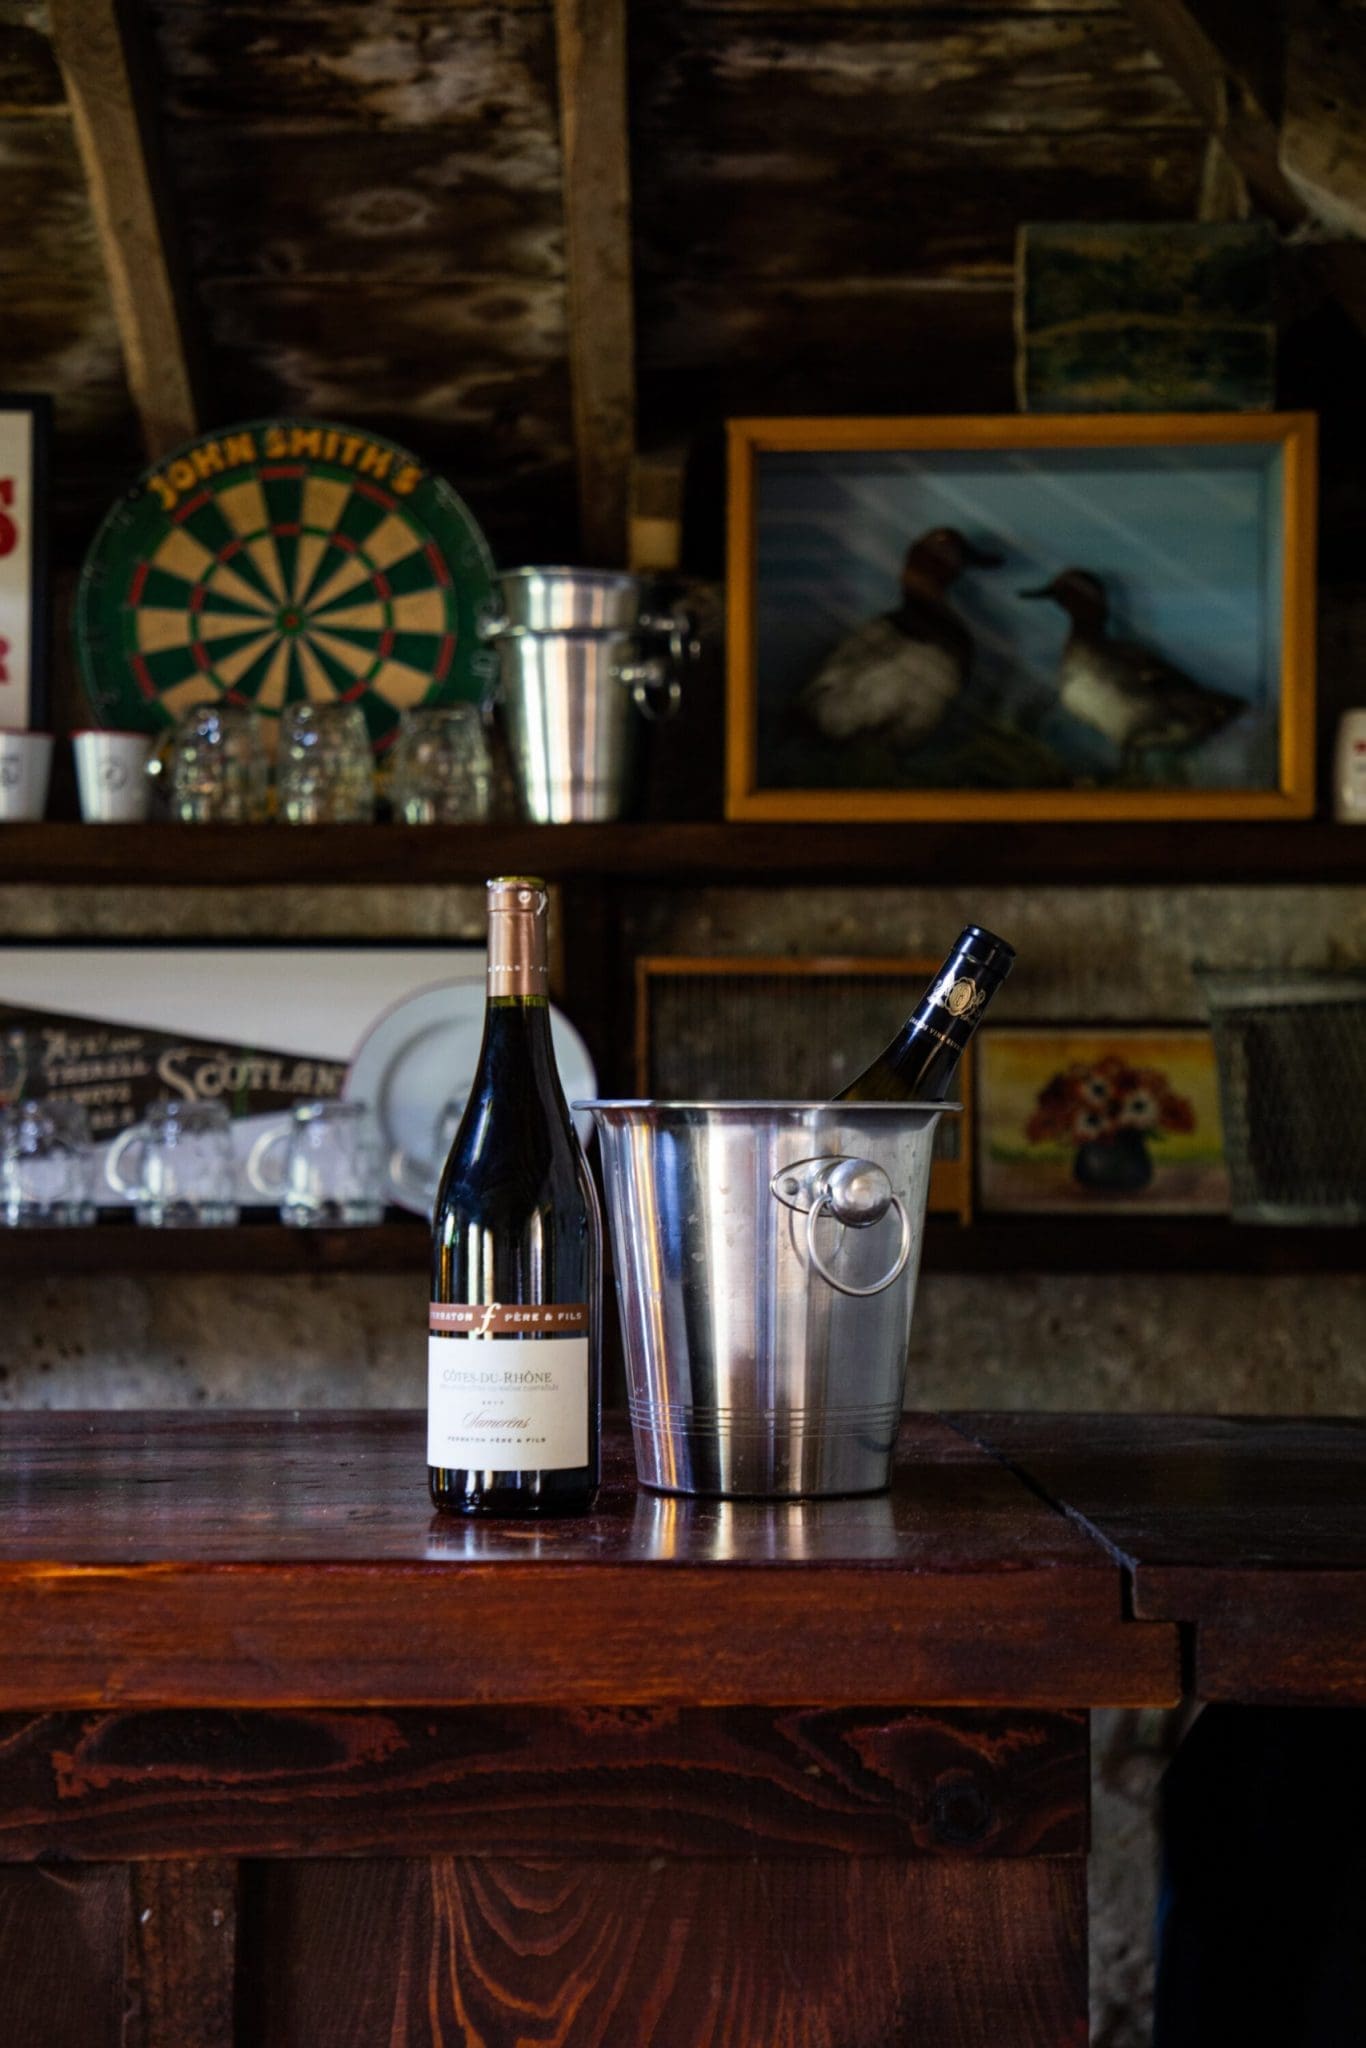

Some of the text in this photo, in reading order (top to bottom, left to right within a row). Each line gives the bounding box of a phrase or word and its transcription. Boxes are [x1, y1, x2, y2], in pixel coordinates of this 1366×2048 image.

[148, 432, 257, 510] JOHN
[504, 1311, 540, 1323] PÈRE
[545, 1313, 553, 1321] &
[557, 1312, 582, 1321] FILS
